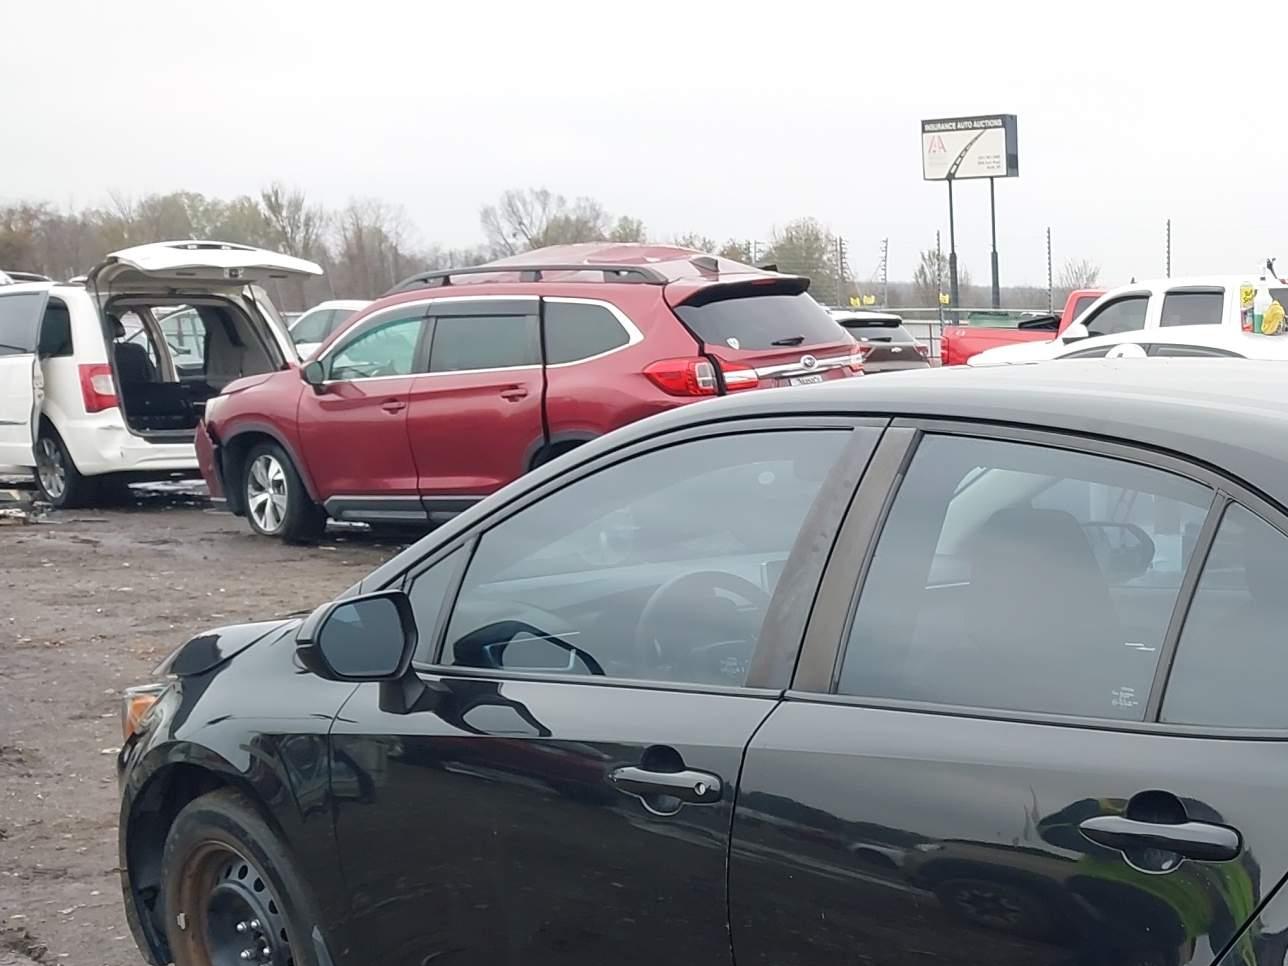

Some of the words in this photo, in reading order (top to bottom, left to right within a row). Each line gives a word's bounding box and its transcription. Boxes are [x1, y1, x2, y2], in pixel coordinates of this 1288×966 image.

[925, 123, 956, 131] INSURANCE
[957, 121, 972, 129] AUTO
[973, 119, 1002, 127] AUCTIONS
